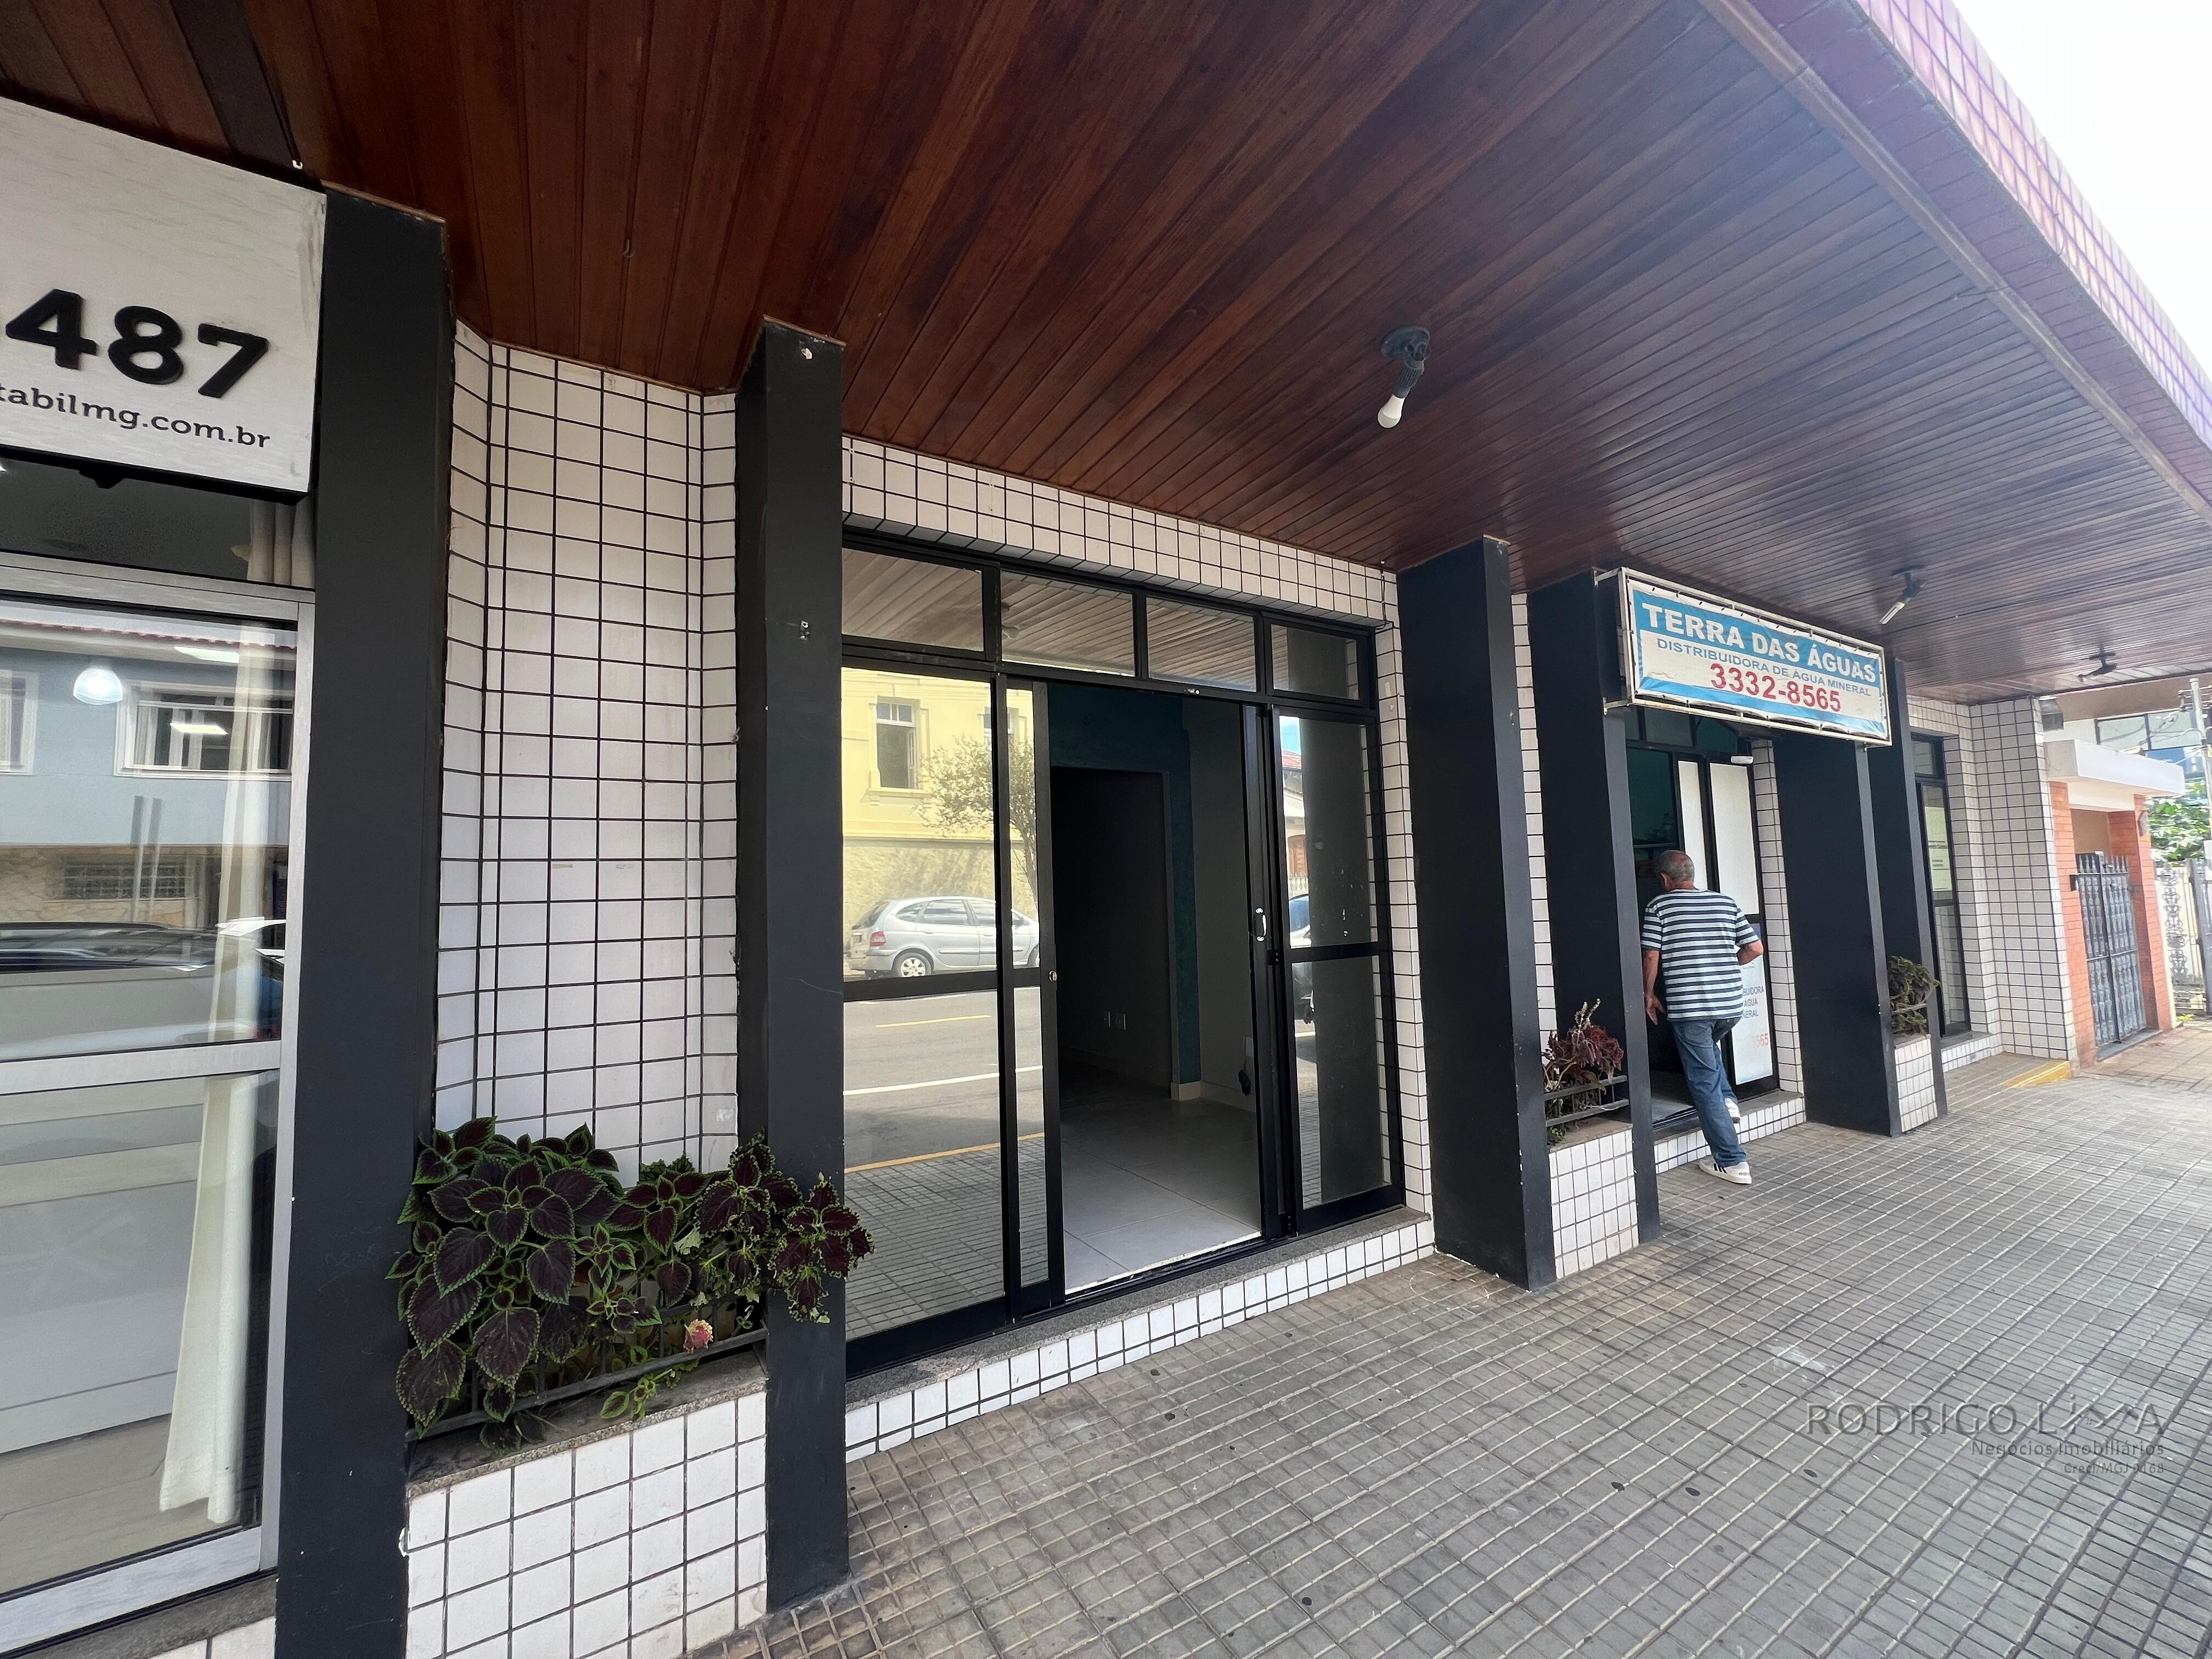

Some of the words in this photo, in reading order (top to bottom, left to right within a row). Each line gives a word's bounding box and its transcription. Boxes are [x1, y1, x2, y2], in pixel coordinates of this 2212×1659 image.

[5, 289, 270, 399] 487
[1642, 602, 1745, 649] TERRA
[1752, 631, 1800, 662] DAS
[1807, 644, 1876, 683] ÁGUAS
[1657, 638, 1769, 673] DISTRIBUIDORA
[1773, 665, 1788, 676] DE
[1793, 669, 1825, 686] ÁGUA
[1827, 679, 1871, 696] MINERAL
[1709, 663, 1841, 712] 3332-8565
[1742, 985, 1764, 996] BUIDORA
